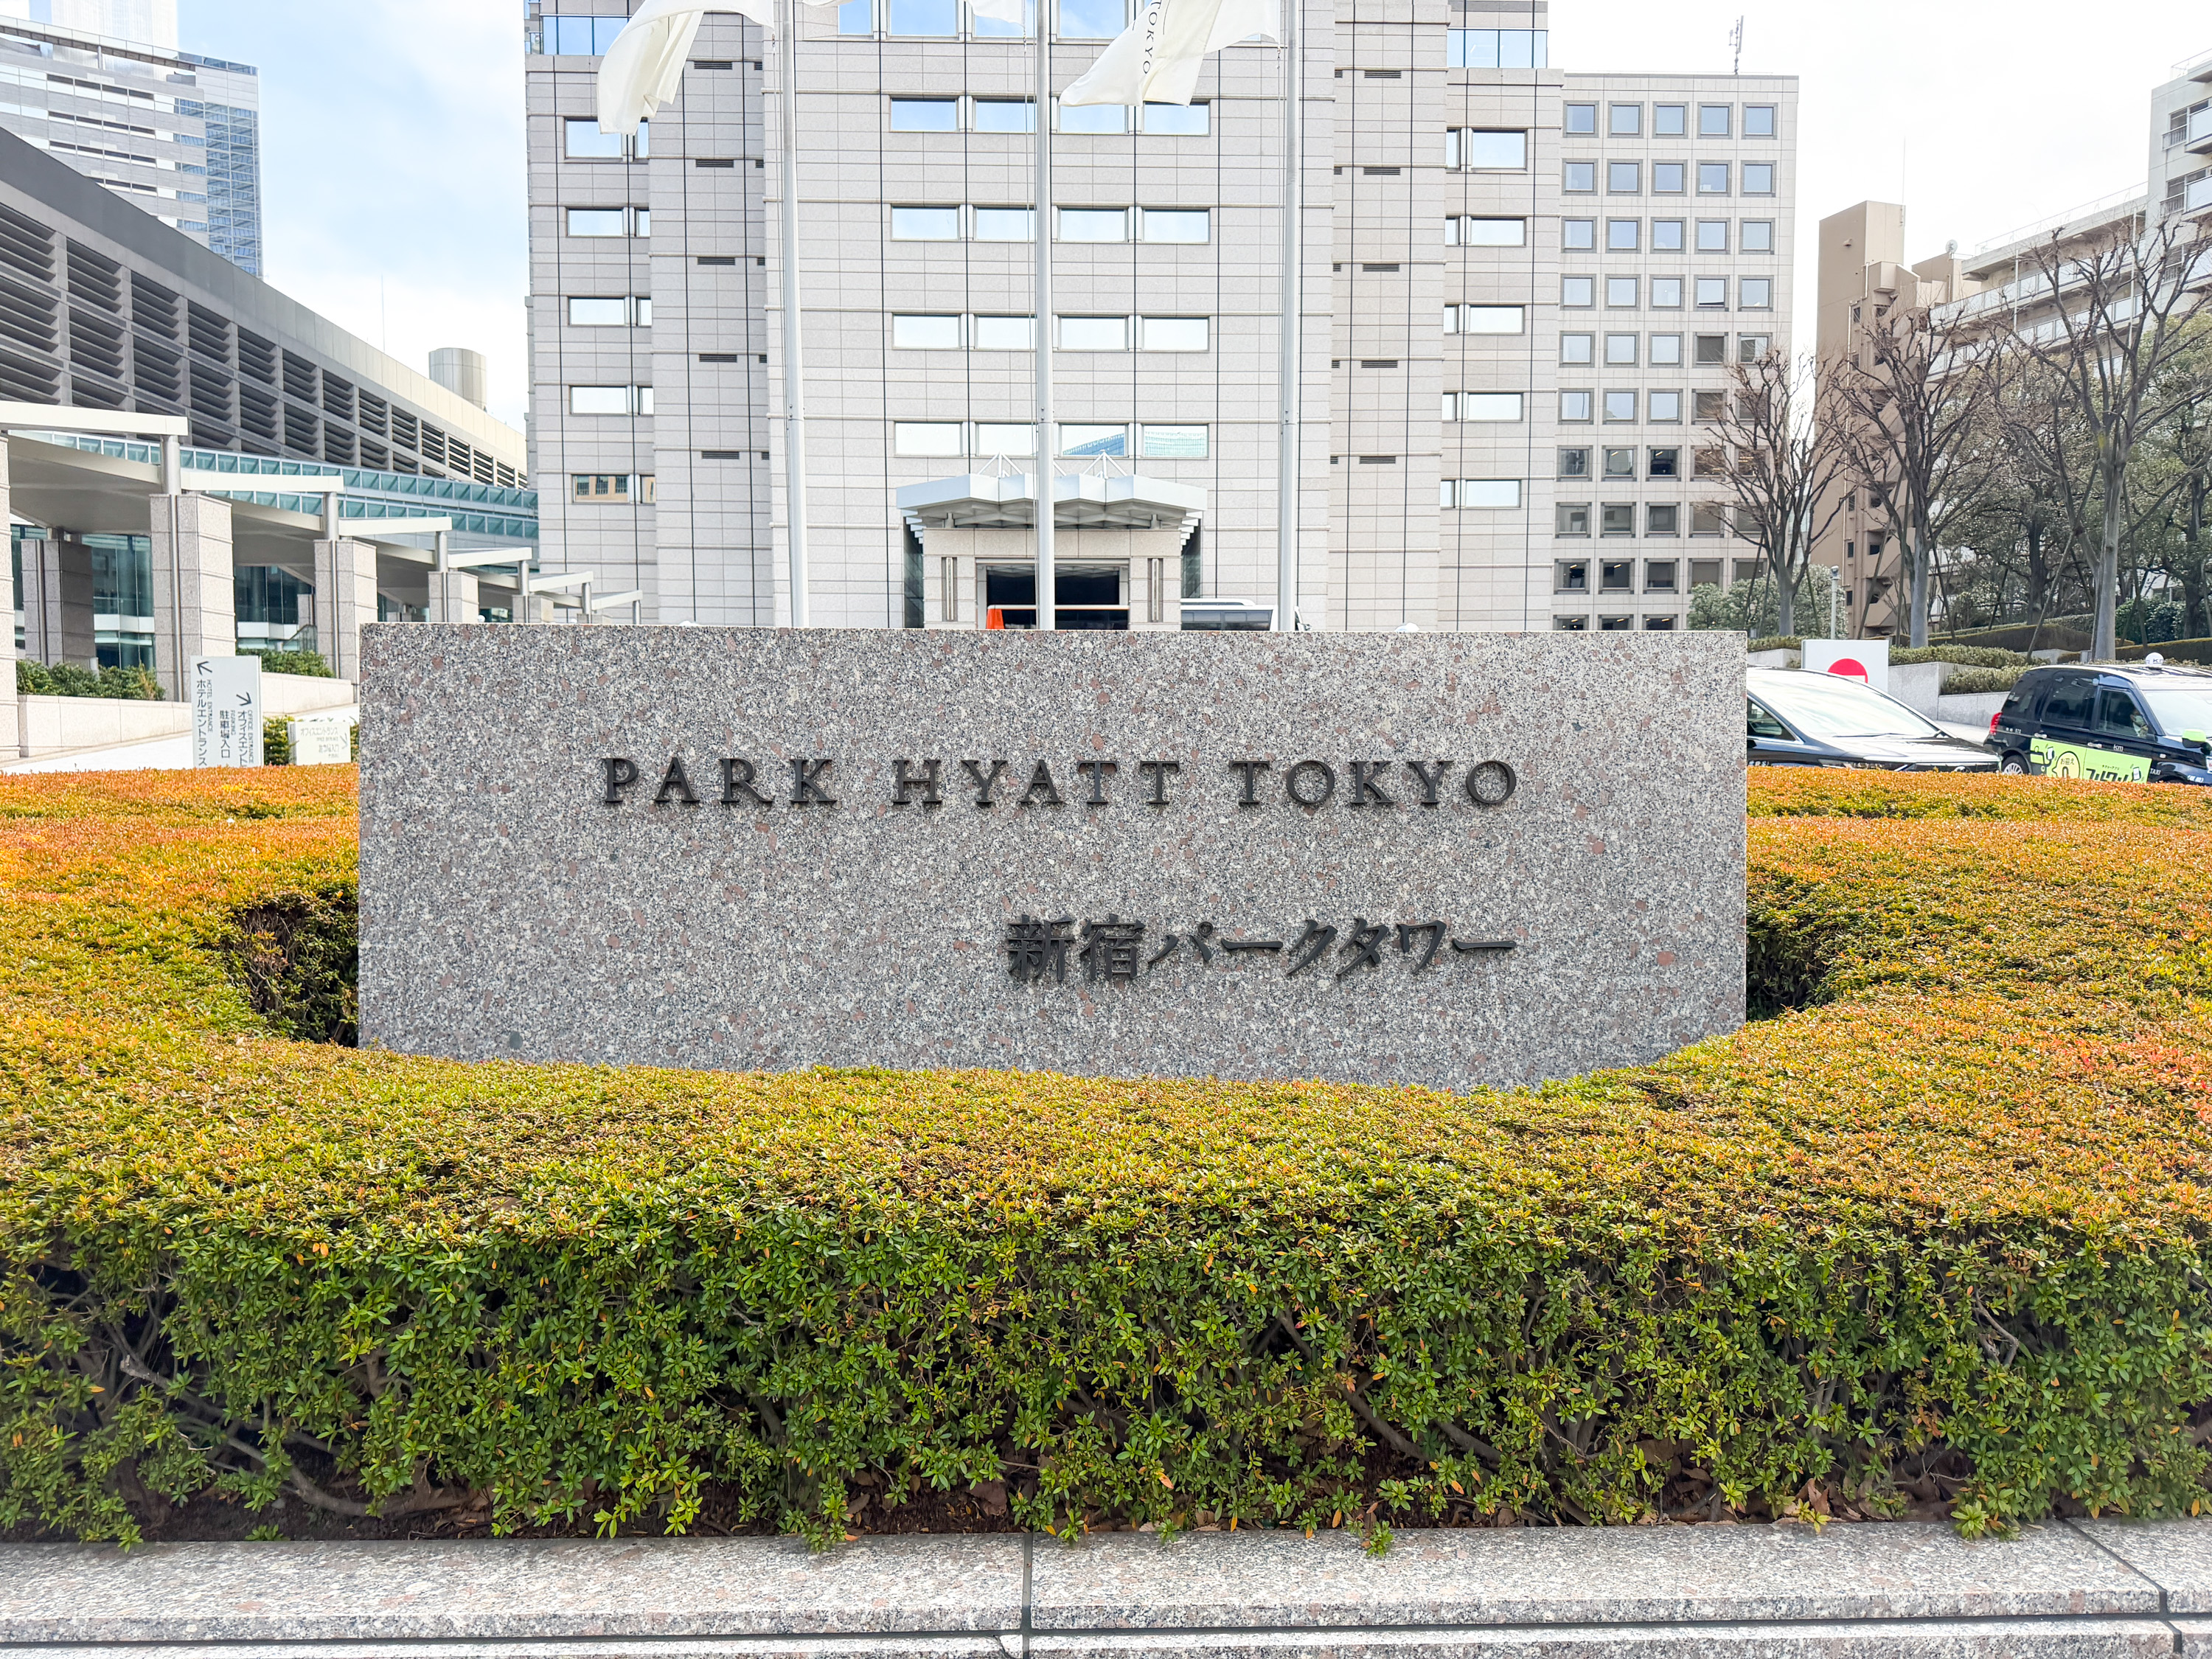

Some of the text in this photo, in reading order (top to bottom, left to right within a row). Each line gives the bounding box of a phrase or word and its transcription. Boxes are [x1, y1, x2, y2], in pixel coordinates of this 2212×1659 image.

[197, 679, 207, 766] ホテルエントランス
[220, 710, 230, 759] 駐車場入口
[237, 711, 248, 767] オフィスエント
[603, 757, 1517, 806] PARK HYATT TOKYO
[2060, 757, 2075, 765] お迎え
[2150, 768, 2161, 776] TAXI
[1007, 913, 1517, 982] 新宿パークタワー
